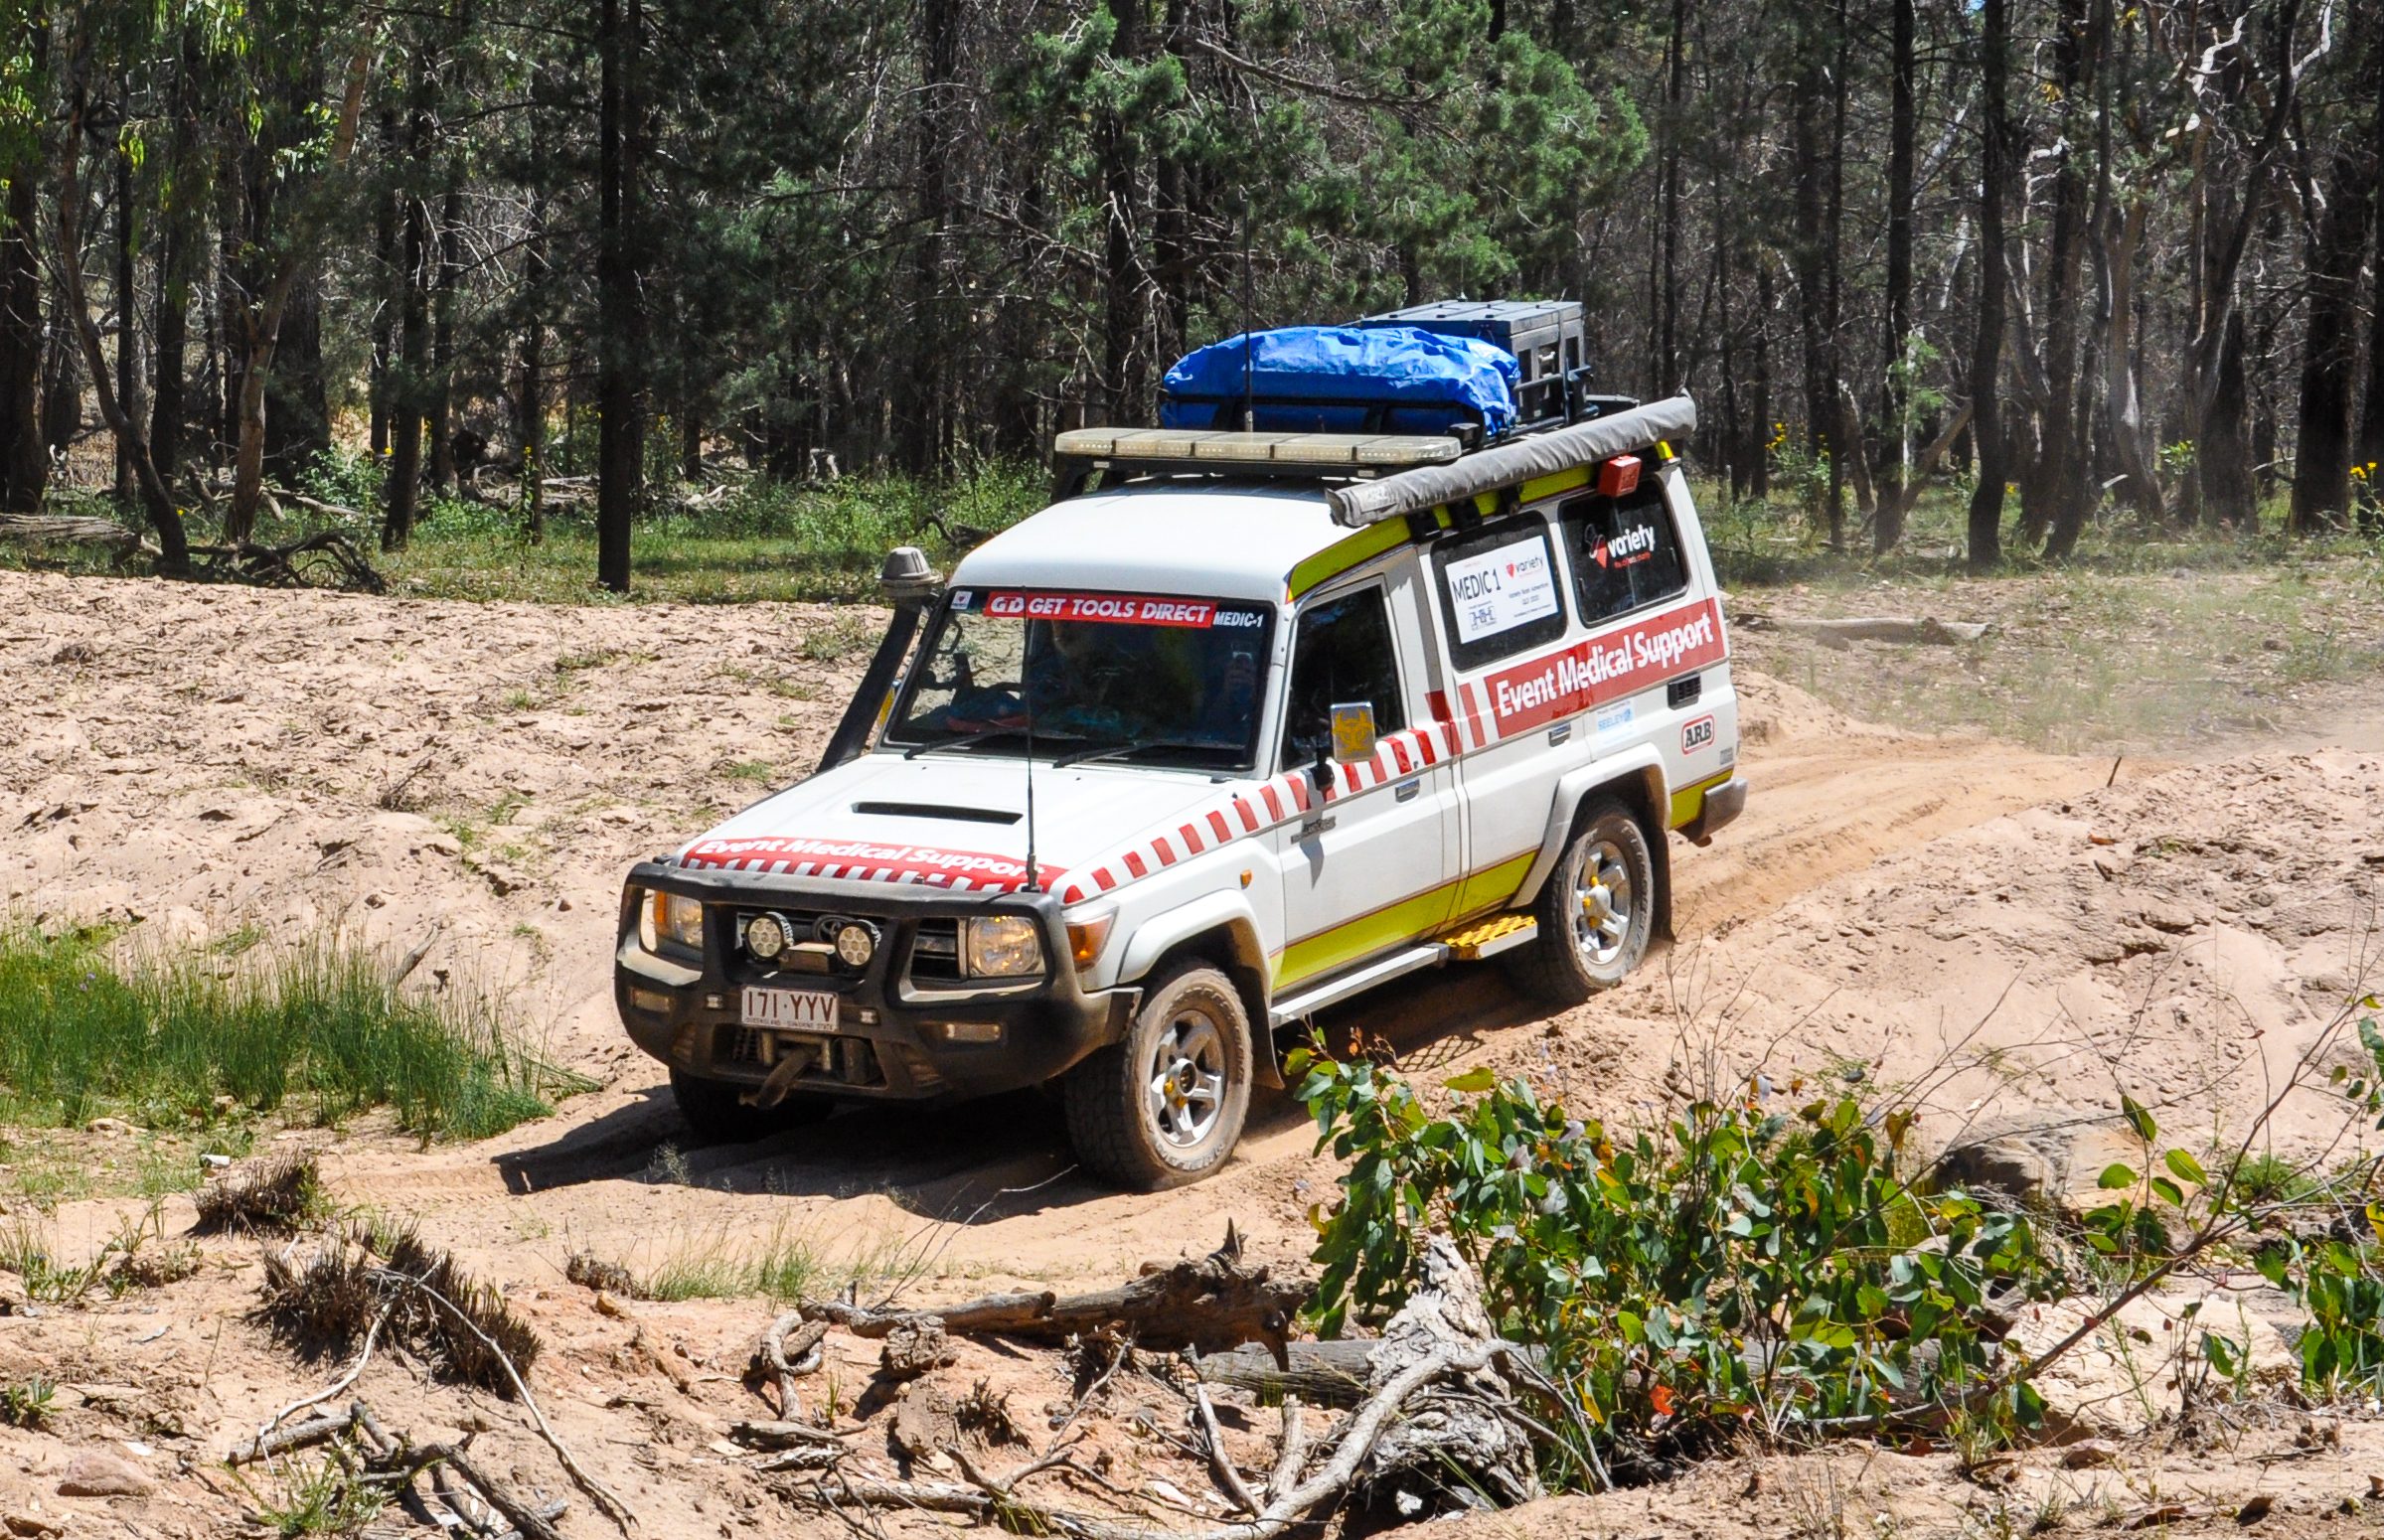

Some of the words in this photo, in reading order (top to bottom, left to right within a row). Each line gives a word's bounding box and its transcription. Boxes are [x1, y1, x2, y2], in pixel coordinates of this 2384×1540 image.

[1607, 524, 1655, 557] variety
[1516, 556, 1543, 573] variety
[1452, 570, 1492, 603] MEDIC
[1493, 568, 1501, 590] 1
[1029, 597, 1066, 615] GET
[1072, 598, 1134, 618] TOOLS
[1141, 602, 1210, 623] DIRECT
[1212, 611, 1264, 628] MEDIC-1
[1496, 668, 1557, 717] Event
[1557, 635, 1634, 696] Medical
[1634, 612, 1714, 669] Support
[1685, 721, 1712, 748] ARB
[697, 839, 785, 855] Event
[788, 840, 908, 861] Medical
